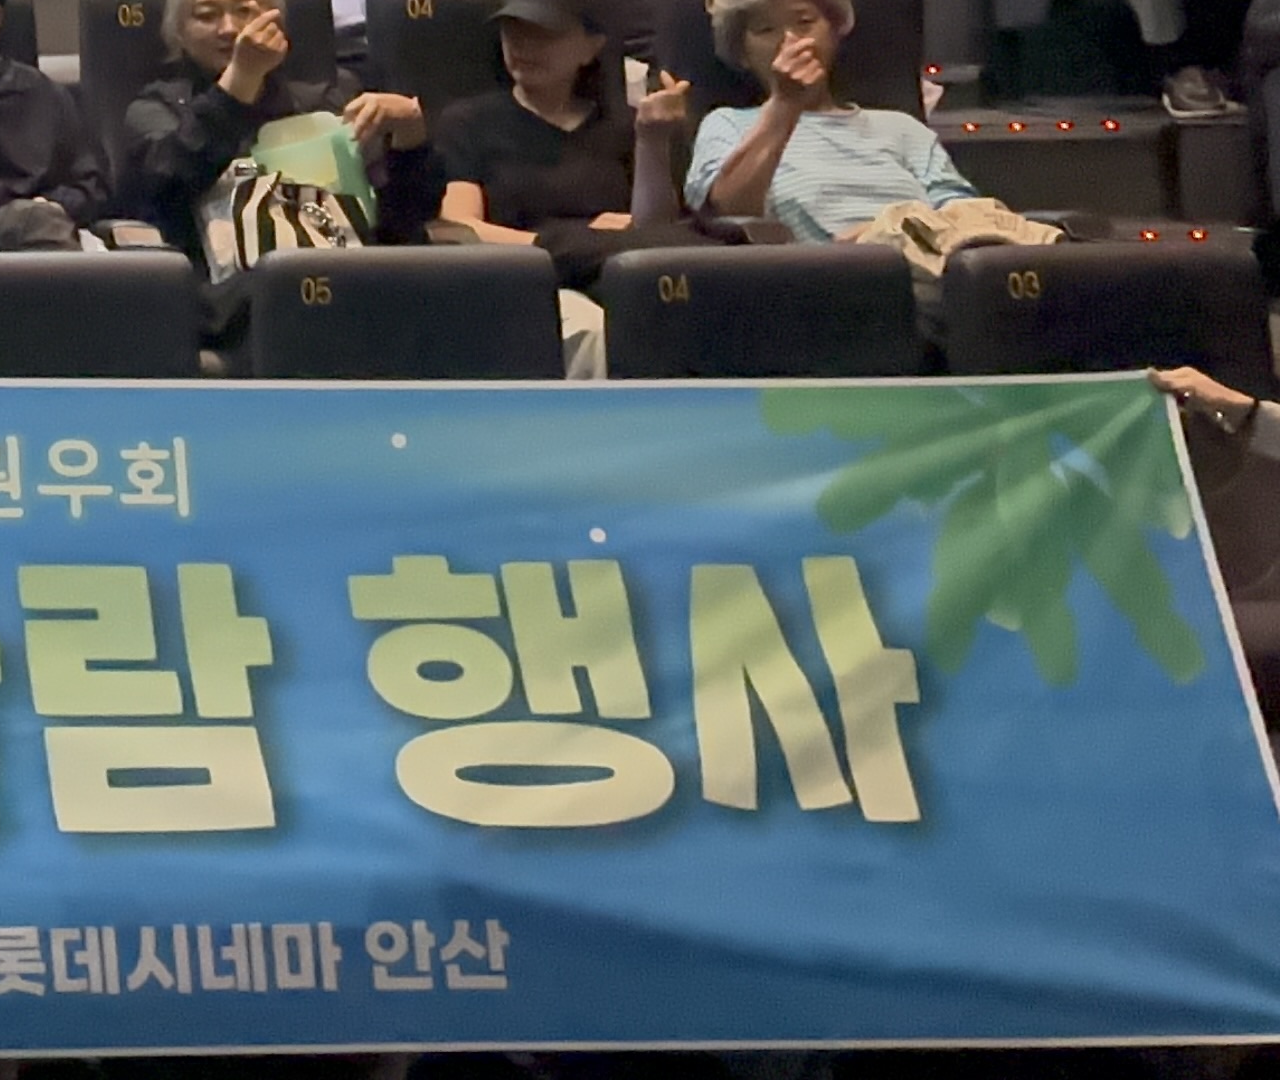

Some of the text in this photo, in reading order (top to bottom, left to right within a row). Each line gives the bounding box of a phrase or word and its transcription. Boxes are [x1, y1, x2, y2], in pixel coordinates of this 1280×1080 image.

[116, 3, 146, 28] 05
[301, 276, 332, 306] 05
[658, 272, 689, 302] 04
[1007, 270, 1040, 300] 03
[346, 554, 922, 829] 행사
[364, 920, 510, 991] 안산
